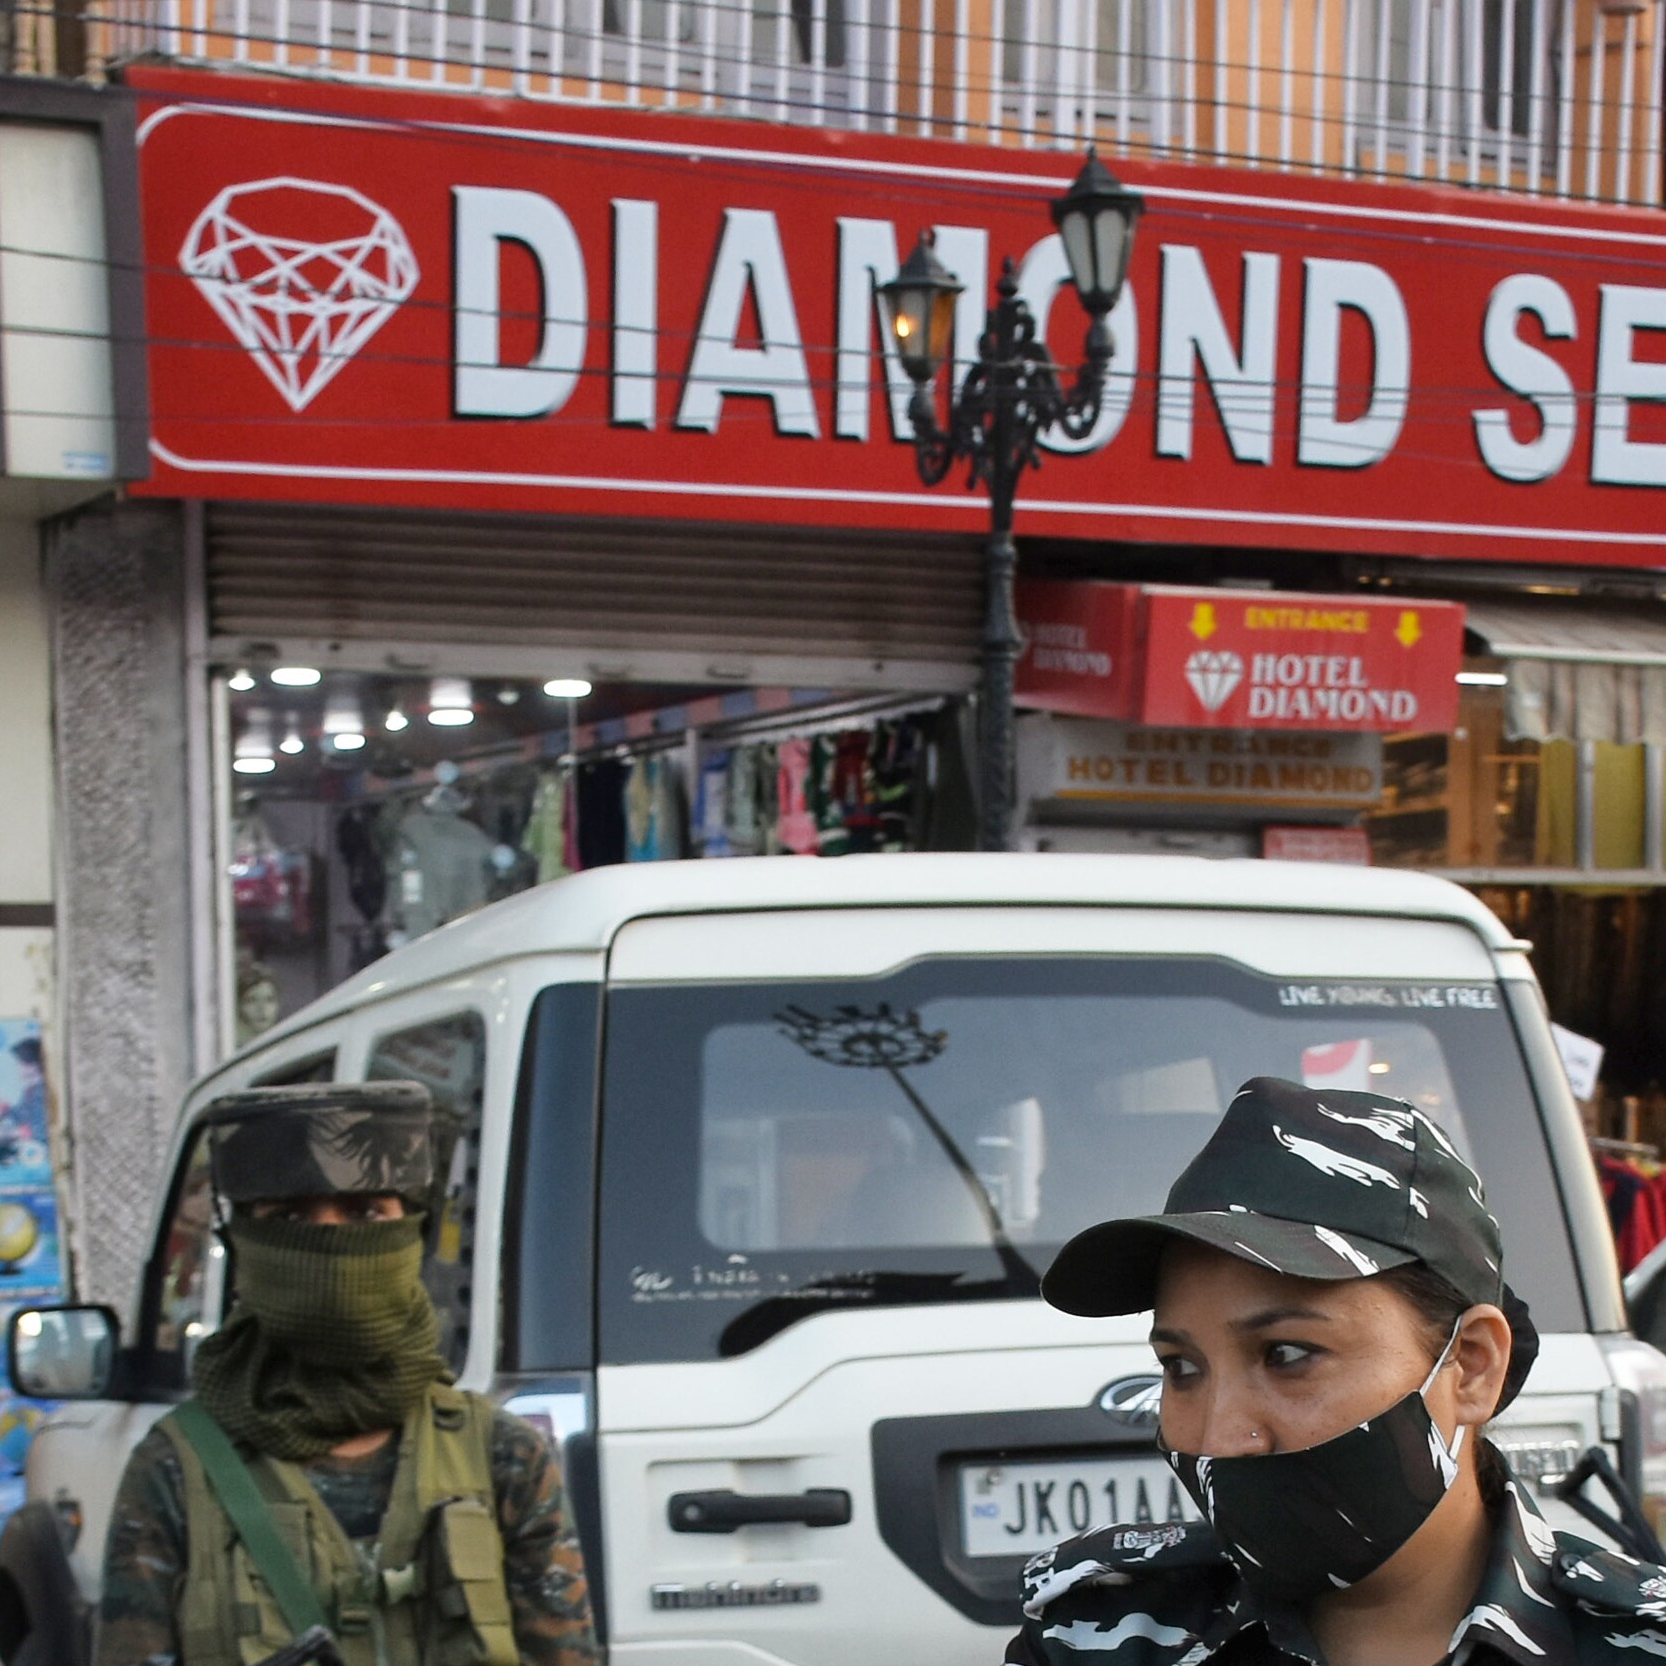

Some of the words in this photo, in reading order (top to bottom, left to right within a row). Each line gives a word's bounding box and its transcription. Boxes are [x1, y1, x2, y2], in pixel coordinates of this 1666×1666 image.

[449, 184, 1412, 469] DIAMOND
[1245, 607, 1369, 633] ENTRANCE
[1251, 654, 1369, 686] HOTEL
[1248, 688, 1418, 722] DIAMOND
[1068, 755, 1193, 787] HOTEL
[1279, 985, 1323, 1006] LIVE
[1400, 987, 1444, 1008] LIVE
[1446, 987, 1498, 1010] FREE
[1004, 1477, 1185, 1535] JK01AA
